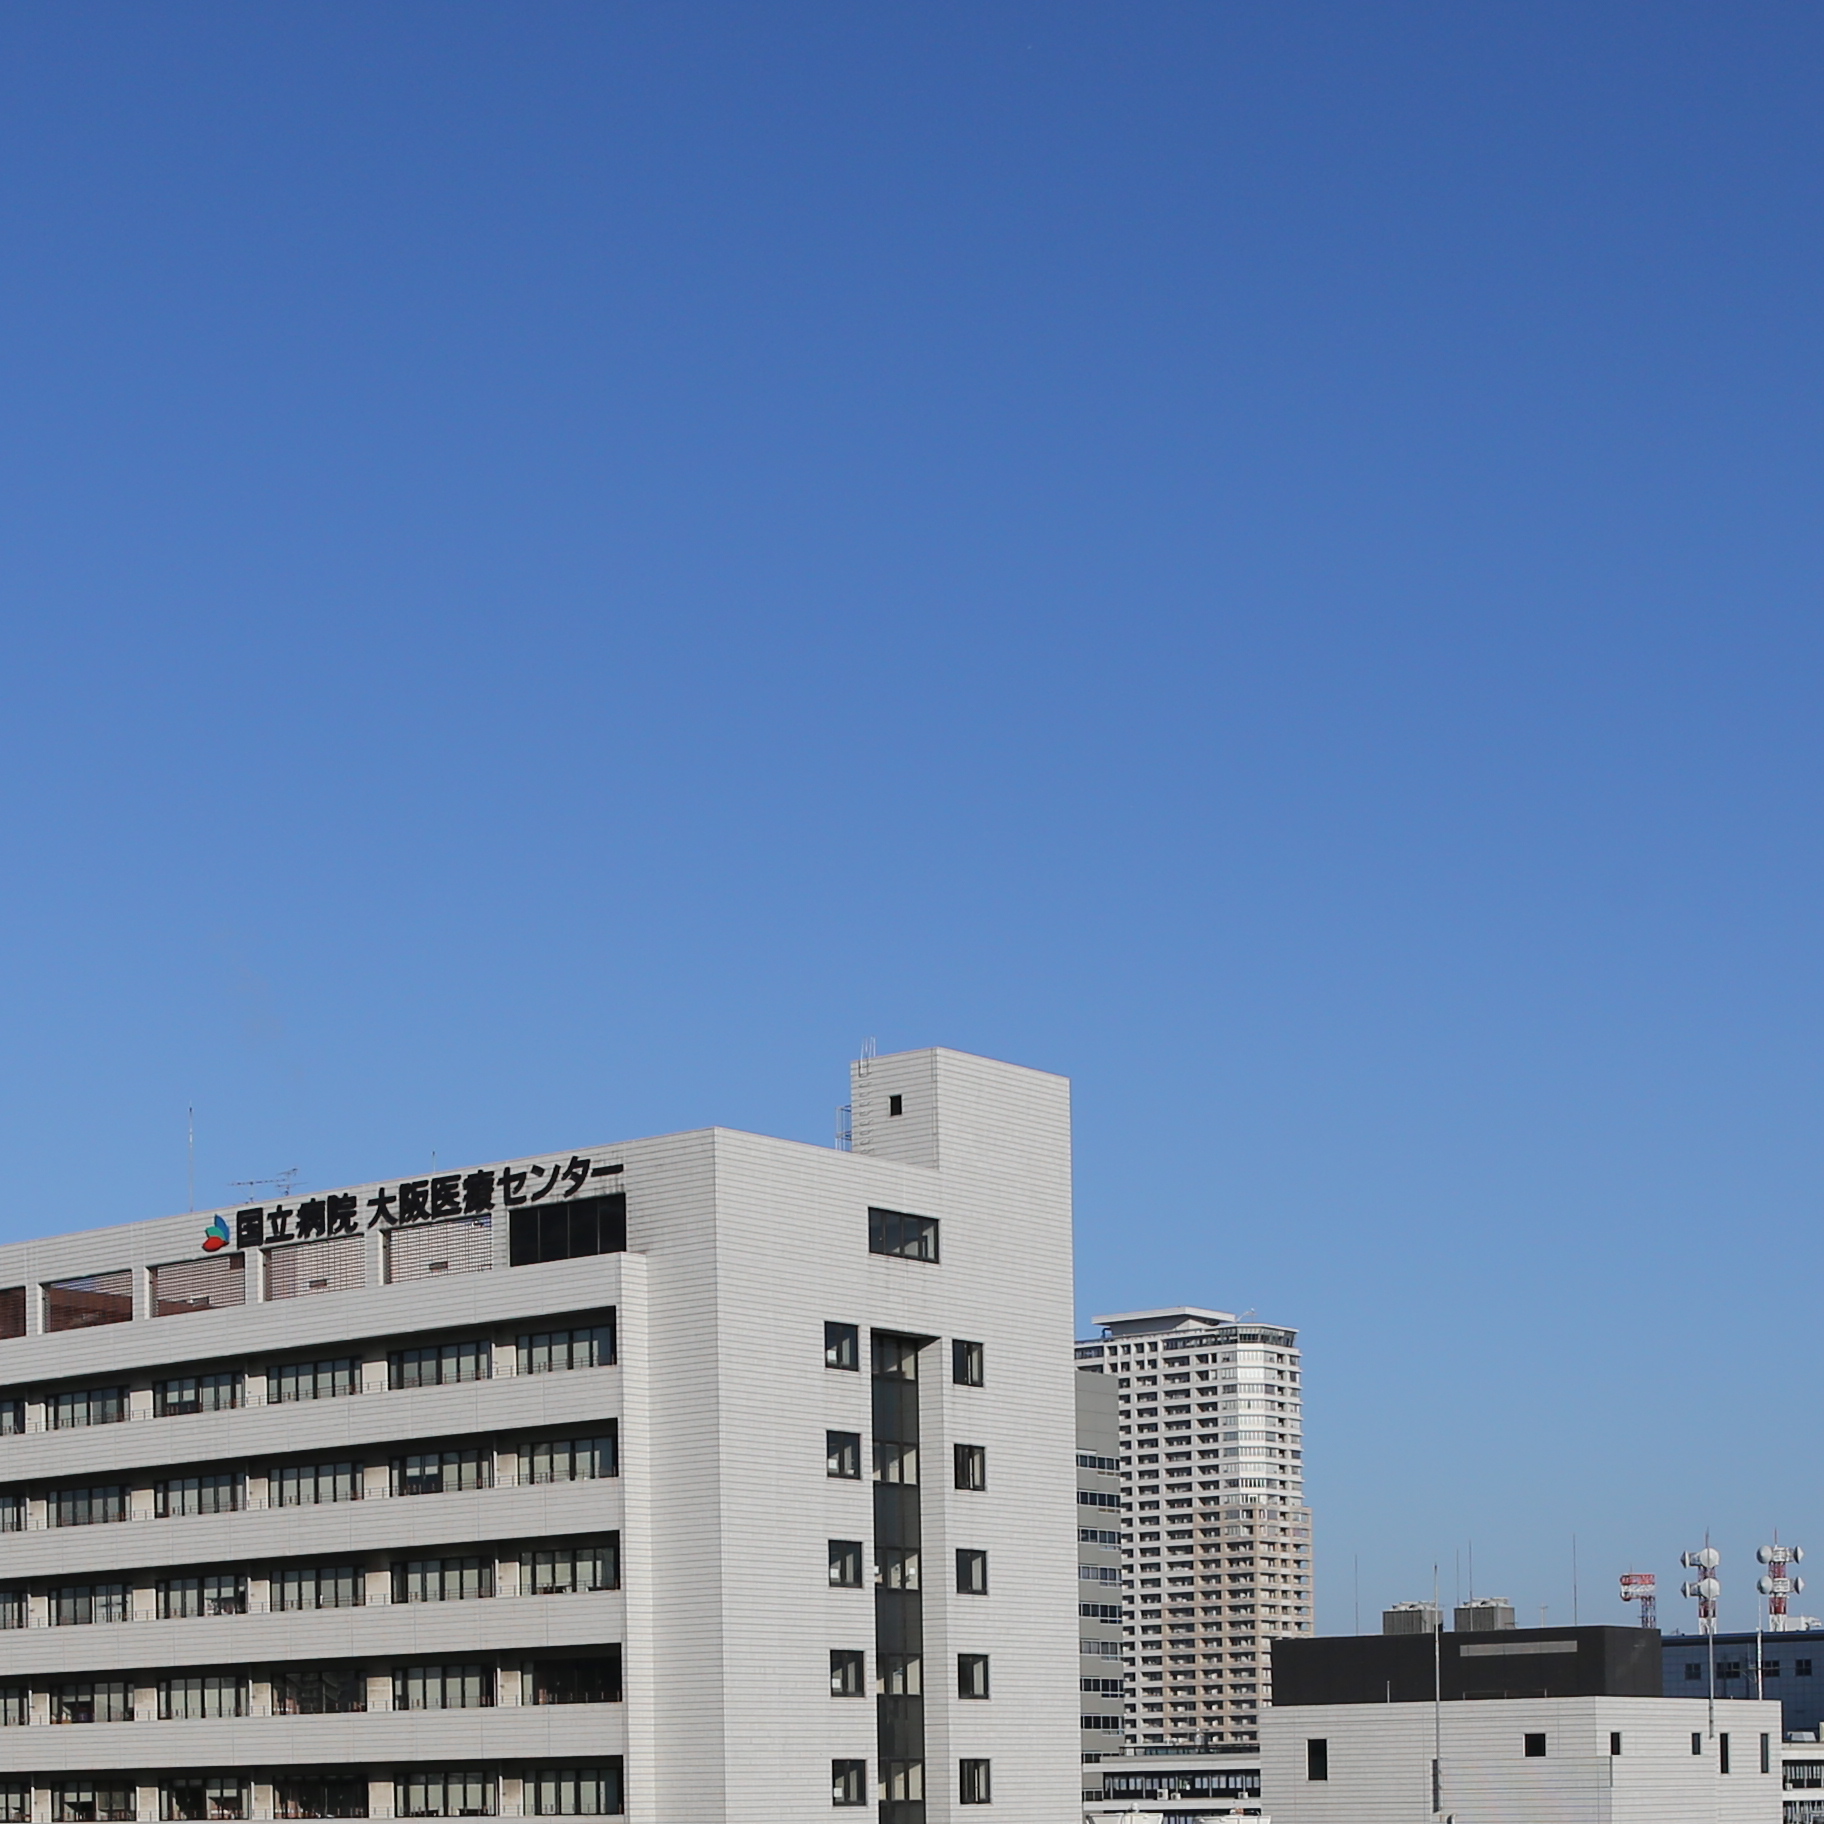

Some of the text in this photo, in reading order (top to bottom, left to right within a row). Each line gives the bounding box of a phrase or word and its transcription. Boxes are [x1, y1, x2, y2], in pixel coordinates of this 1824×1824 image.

[236, 1156, 624, 1250] 国立病院 大阪医療センター
